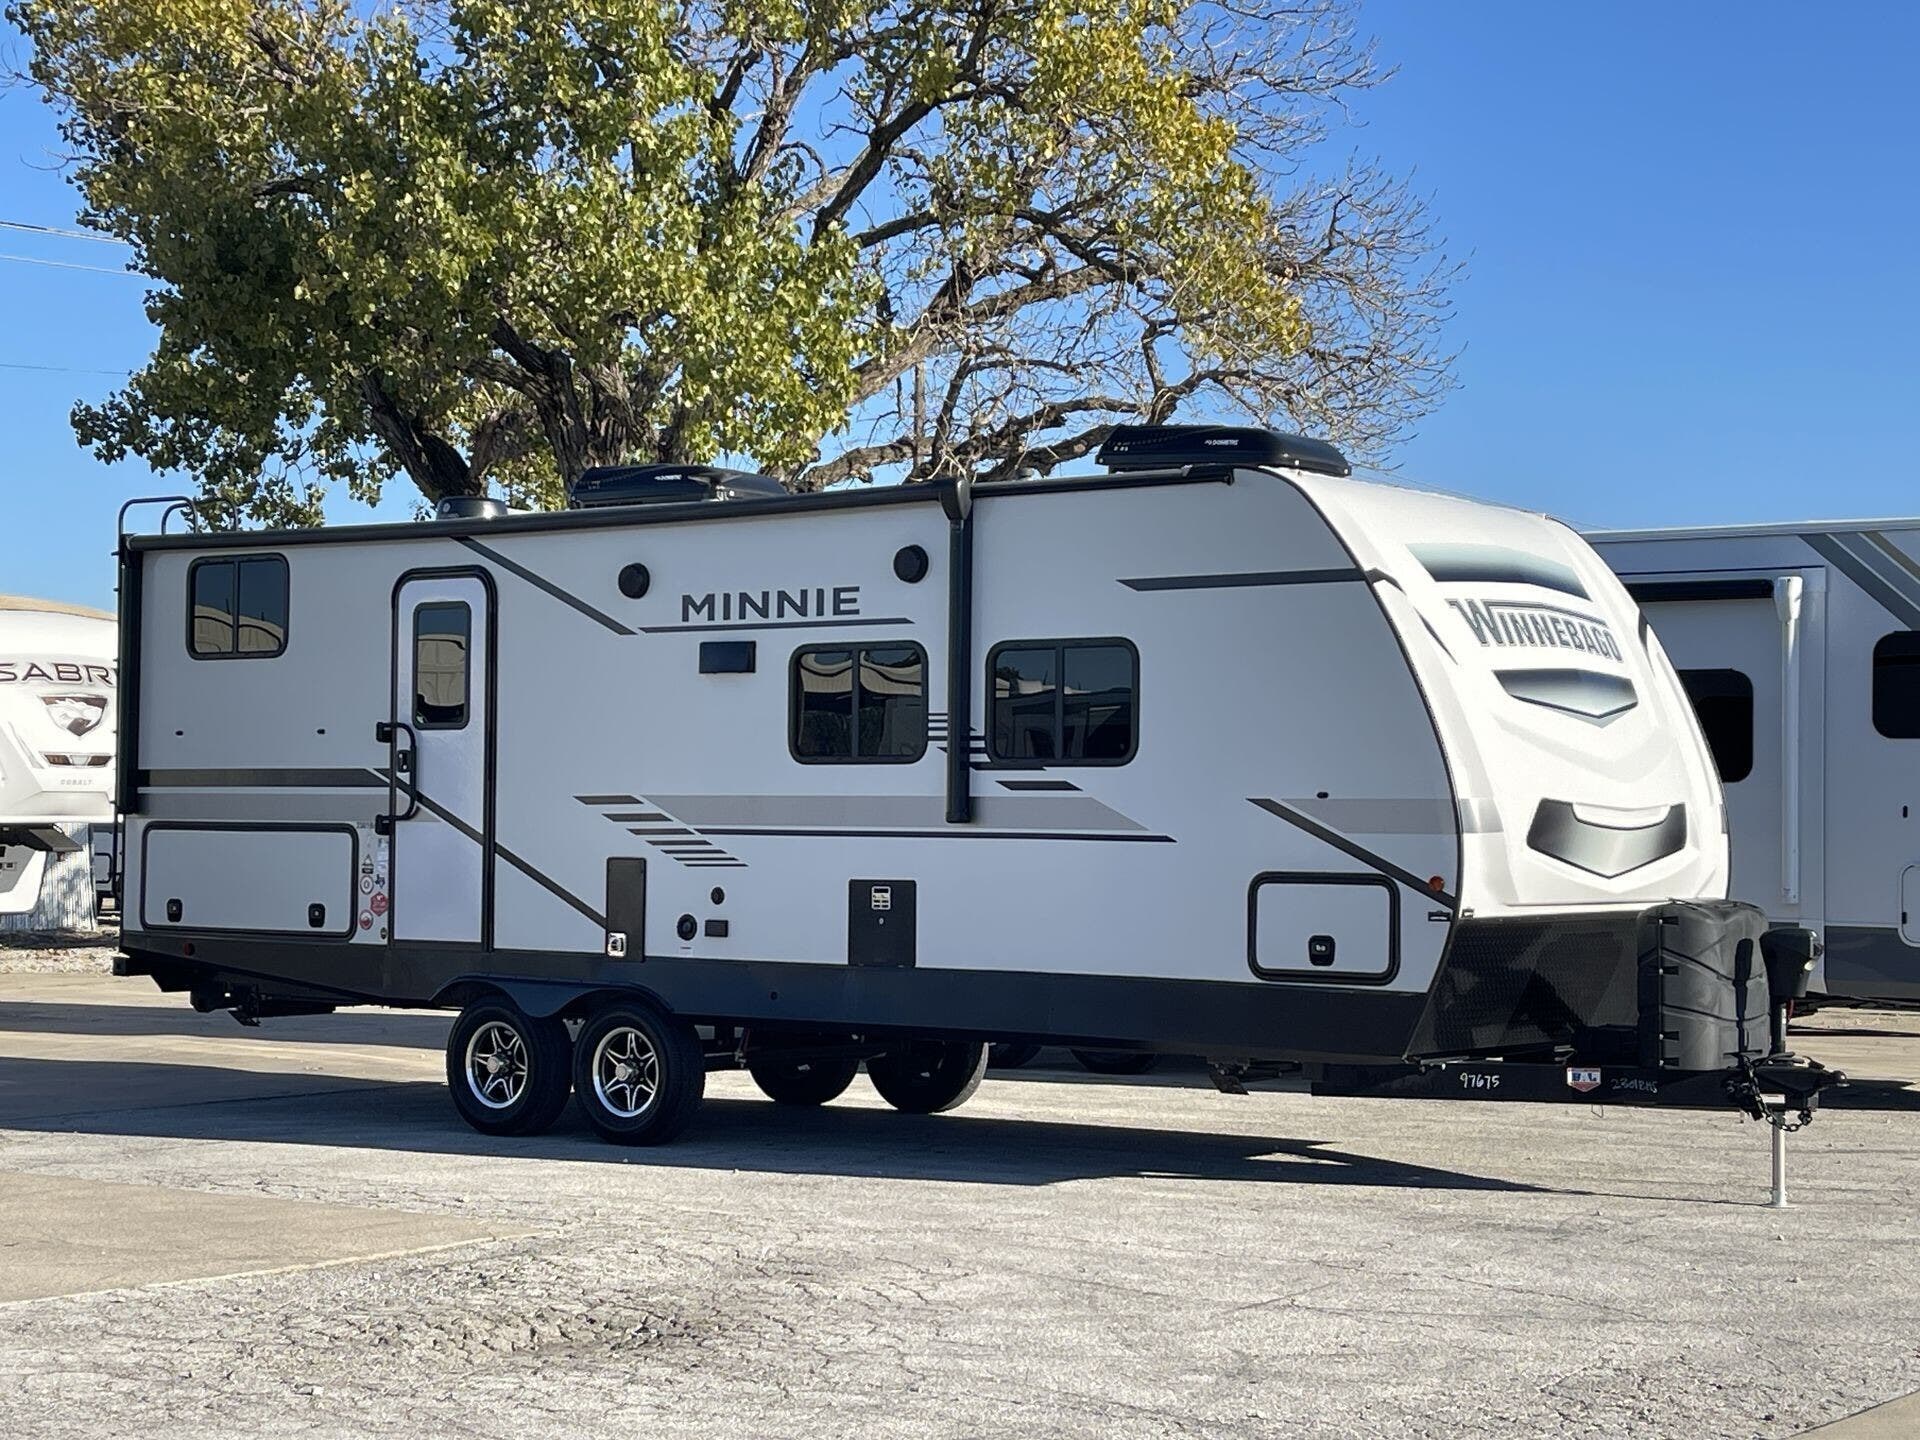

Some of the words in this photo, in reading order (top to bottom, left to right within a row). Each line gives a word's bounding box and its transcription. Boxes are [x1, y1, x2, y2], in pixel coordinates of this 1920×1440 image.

[682, 586, 860, 622] MINNIE
[1445, 598, 1624, 663] WINNEBAGO
[0, 662, 118, 686] SABR
[1459, 1072, 1500, 1090] 97675
